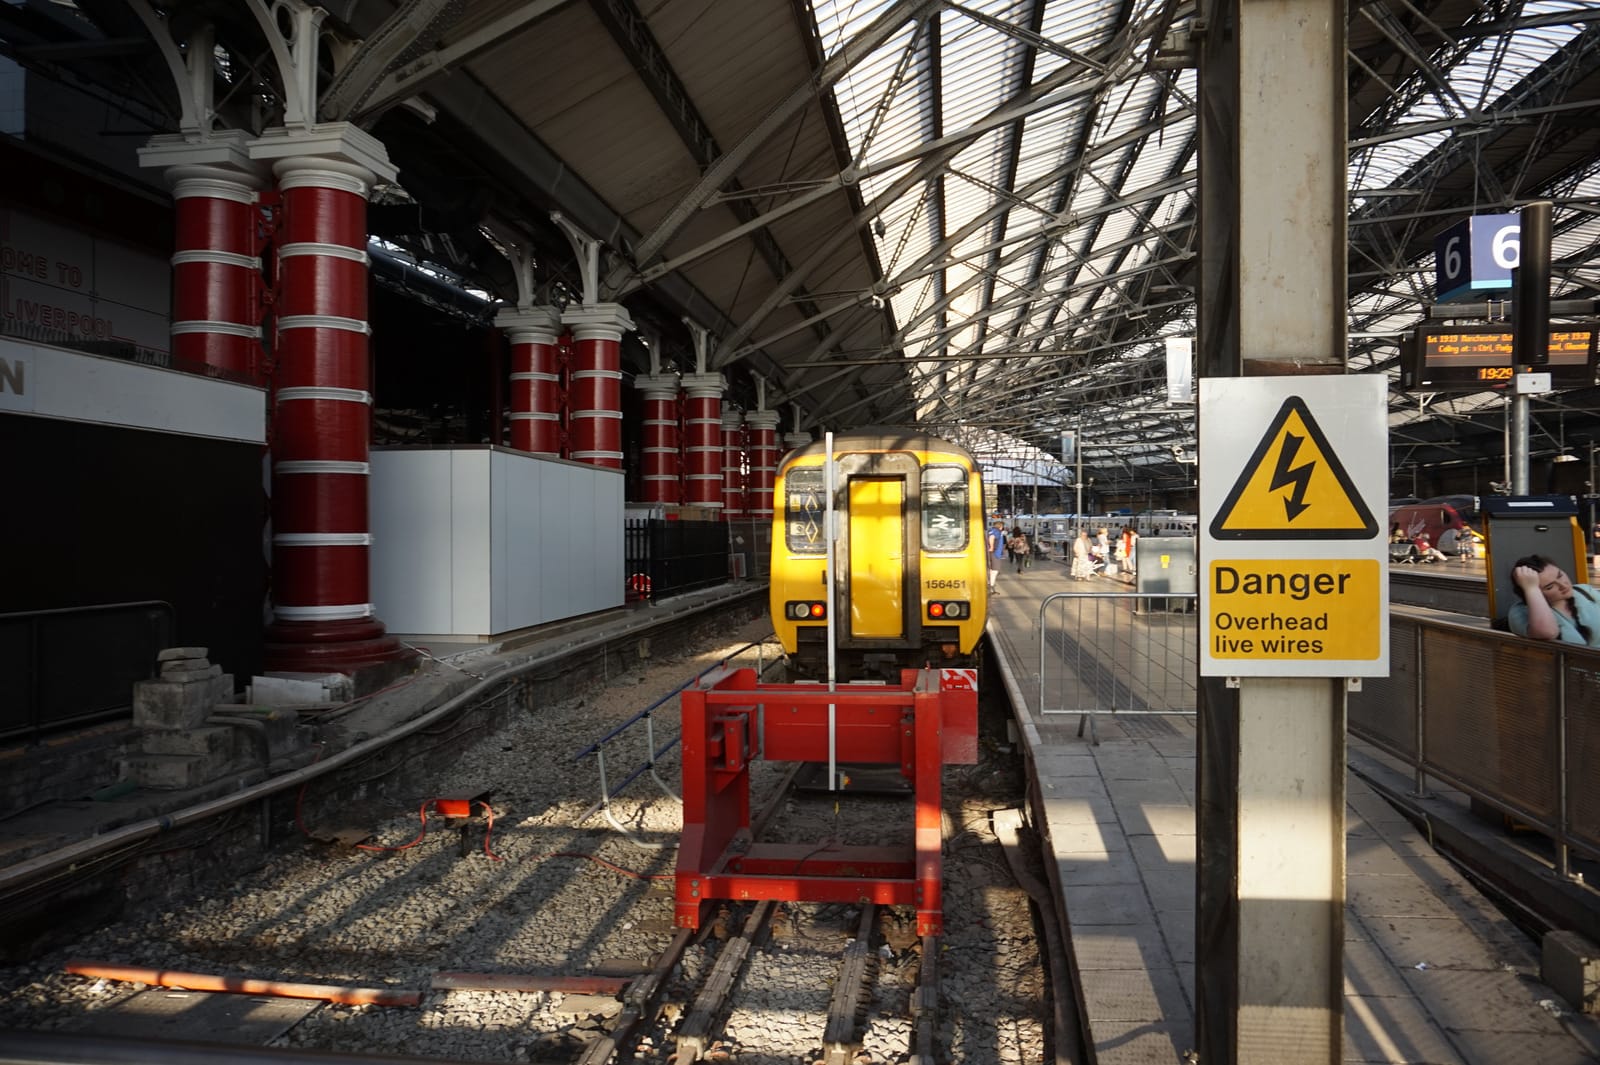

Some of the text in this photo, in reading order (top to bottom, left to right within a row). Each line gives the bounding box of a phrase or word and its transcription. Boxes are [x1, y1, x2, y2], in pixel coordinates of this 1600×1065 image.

[1444, 236, 1462, 280] 6
[1492, 225, 1521, 270] 6
[56, 261, 83, 289] TO
[926, 579, 966, 589] 156451
[1215, 566, 1351, 601] Danger
[1215, 612, 1328, 631] Overhead
[1215, 635, 1324, 654] live wires
